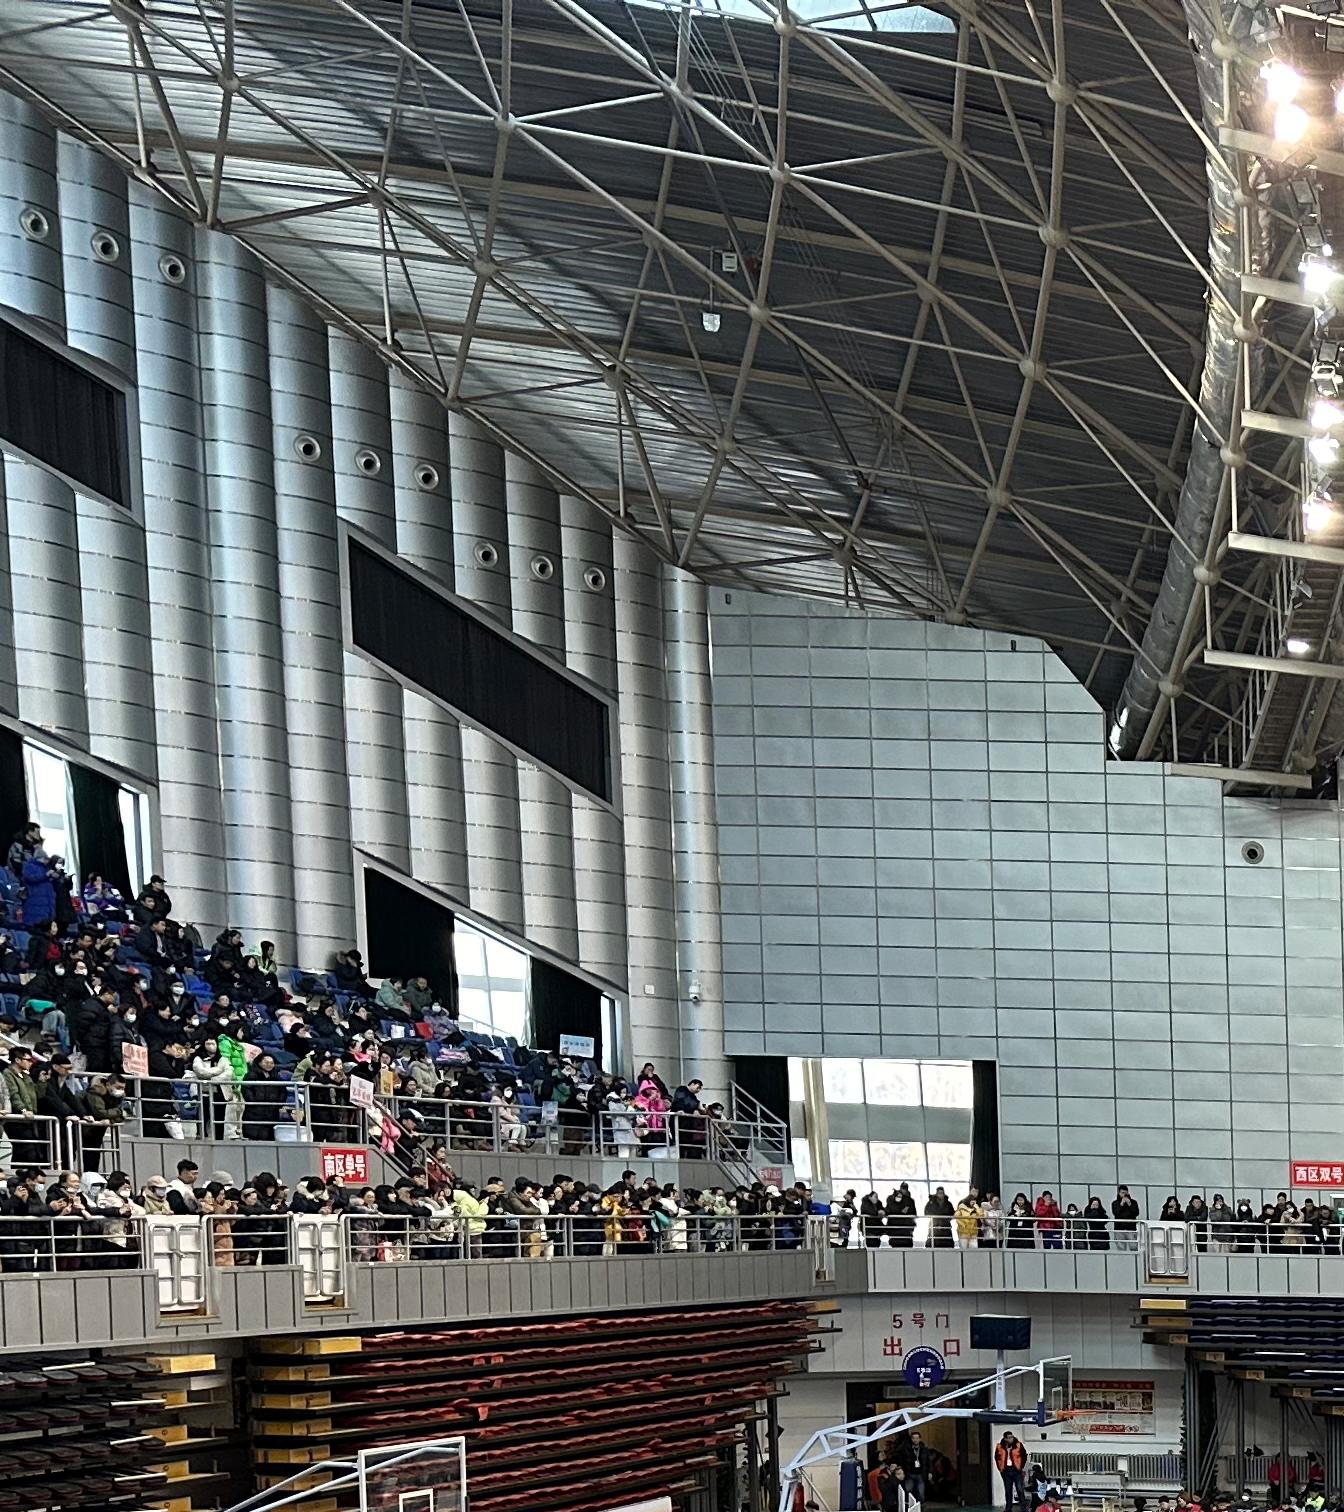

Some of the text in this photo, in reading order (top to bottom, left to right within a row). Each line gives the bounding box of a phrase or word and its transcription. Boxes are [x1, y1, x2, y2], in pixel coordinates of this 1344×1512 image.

[323, 1153, 366, 1178] 南区单号
[1294, 1166, 1344, 1183] 西区双号
